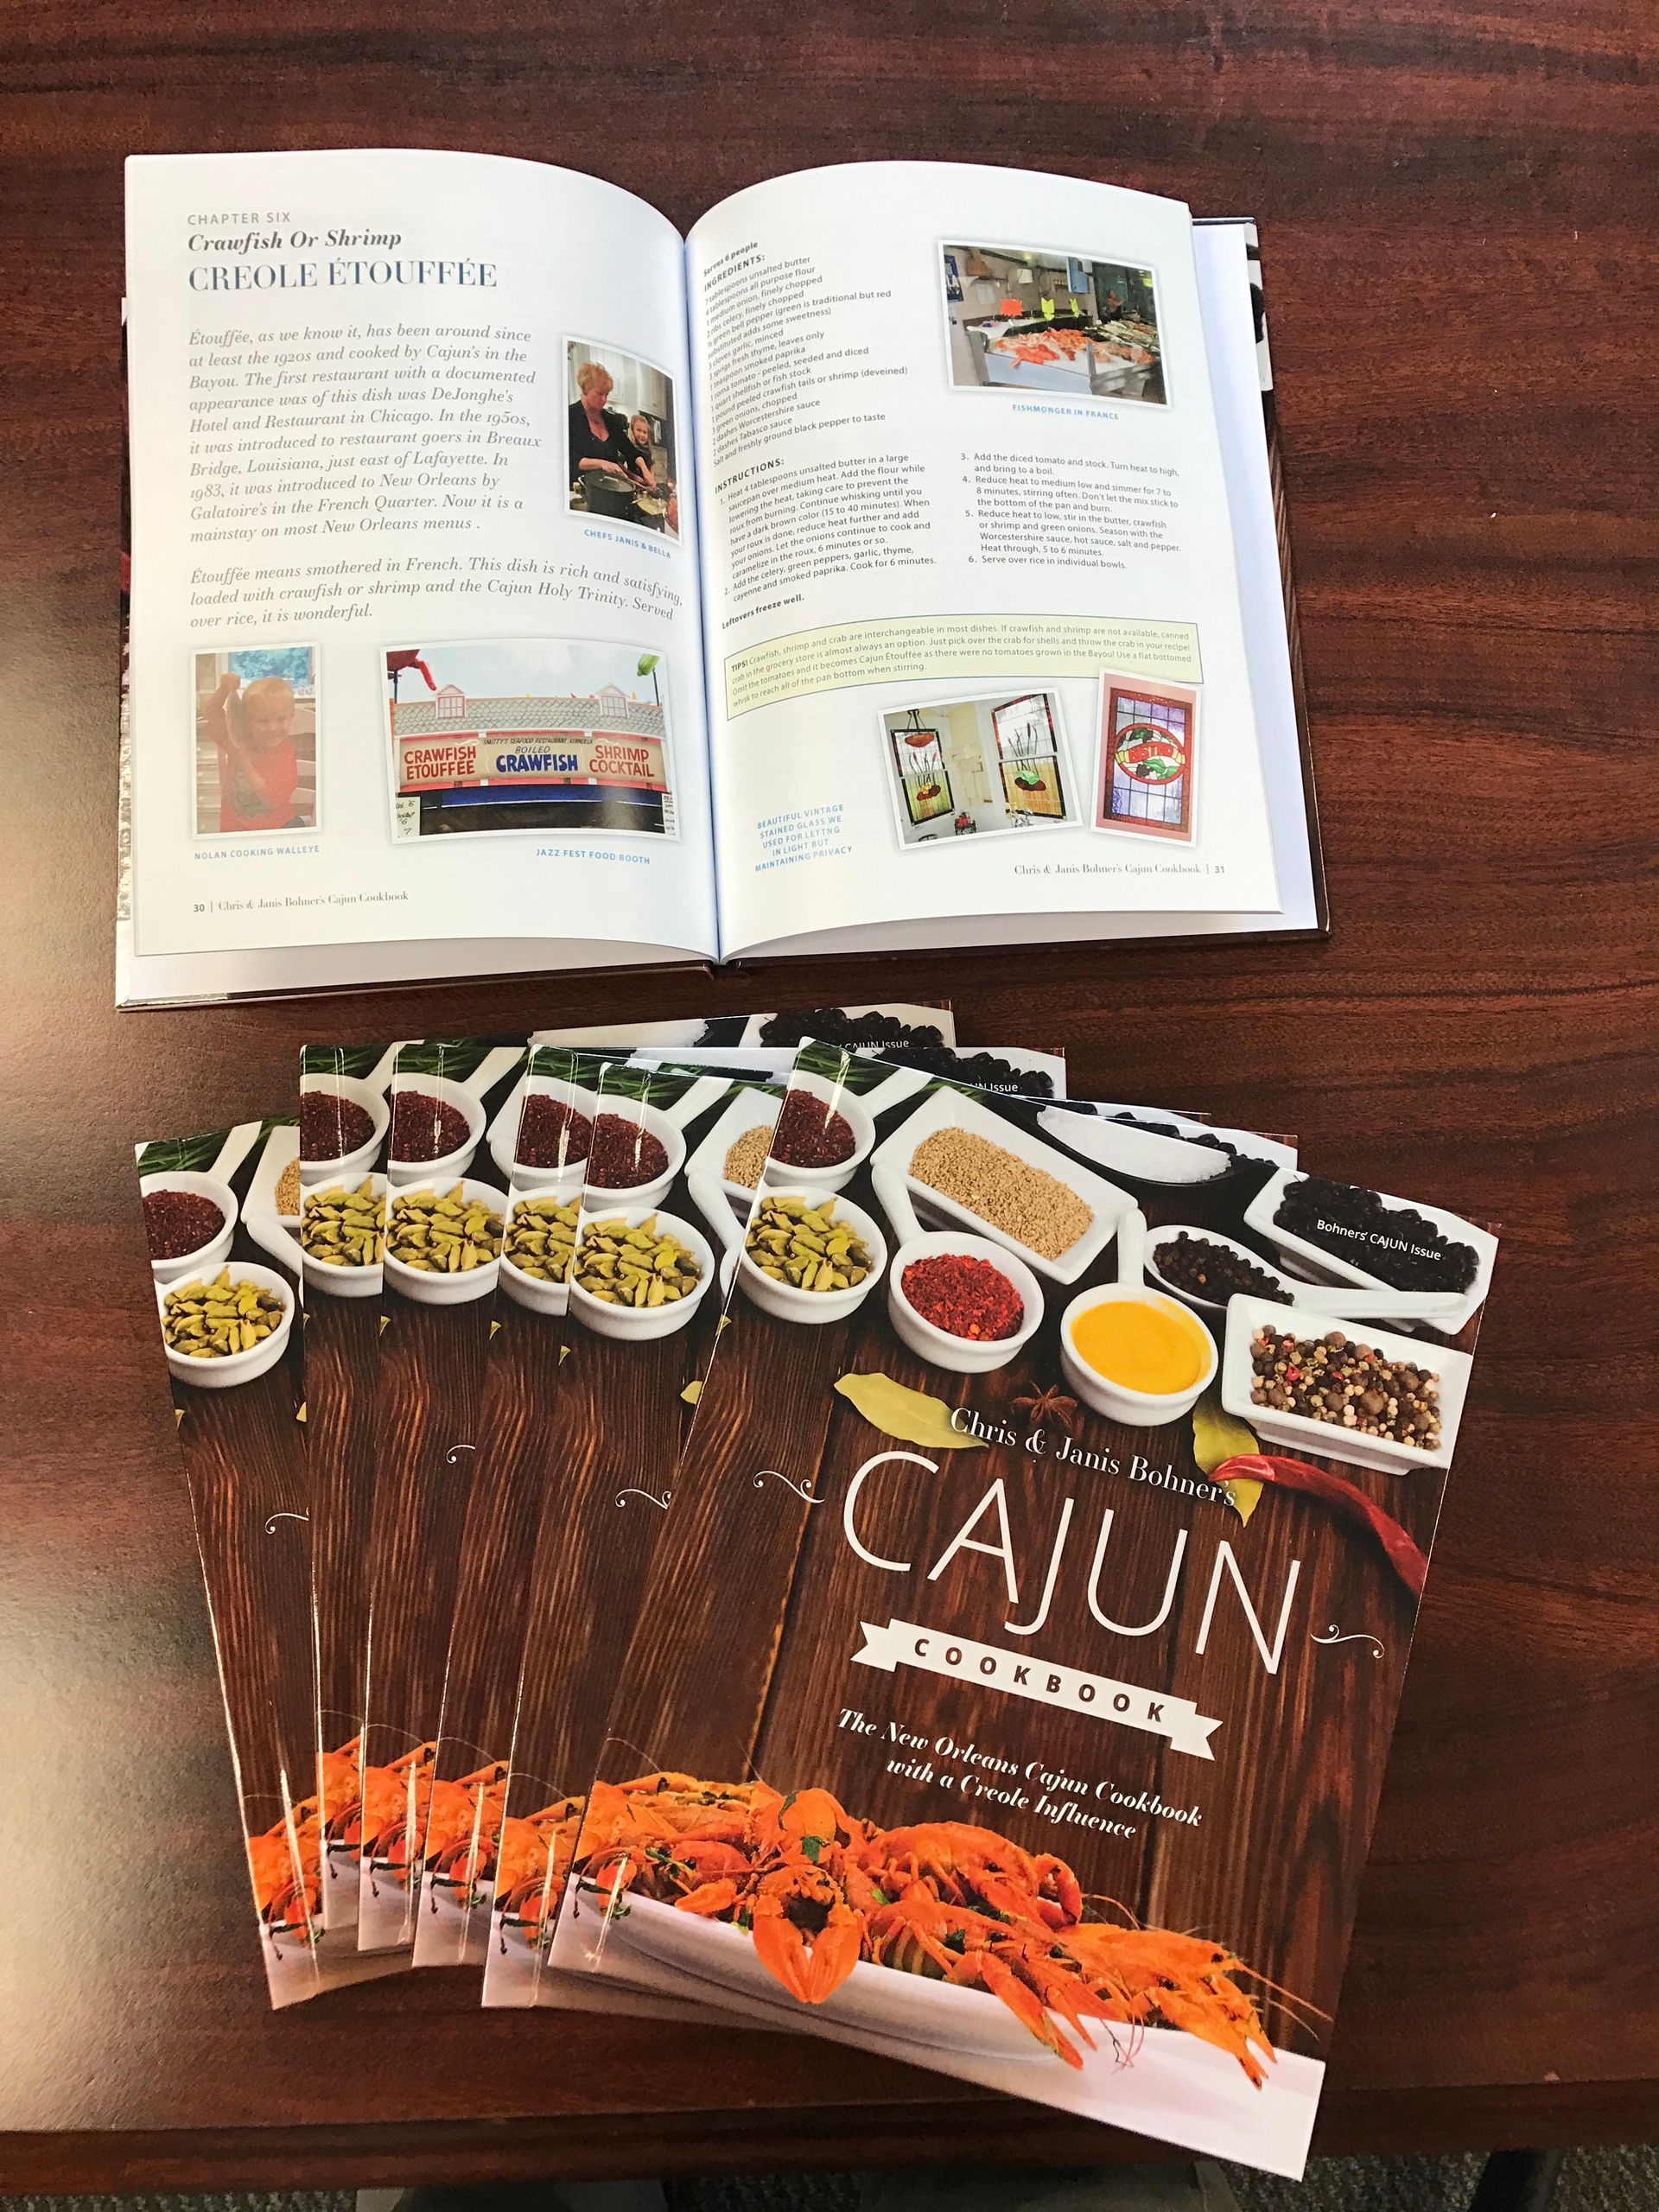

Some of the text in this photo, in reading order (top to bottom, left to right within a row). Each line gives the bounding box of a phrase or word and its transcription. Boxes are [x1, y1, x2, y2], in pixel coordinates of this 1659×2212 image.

[187, 211, 290, 226] CHAPTER SIX
[188, 228, 402, 256] Crawfish Or Shrimp
[702, 241, 758, 277] Serves 6 people
[188, 257, 497, 291] CREOLE ÉTOUFFÉE
[703, 253, 766, 292] INGREDIENTS:
[188, 321, 531, 348] Étouffée, as we know it, has been around since
[188, 343, 527, 367] at least the 1920s and cooked by Cajun's in the
[188, 365, 537, 392] Bayou. The first restaurant with a documented
[188, 386, 513, 414] appearance was of this dish was DeJonghe's
[1012, 404, 1072, 416] FISHMONGER
[1085, 410, 1119, 420] FRANCE
[715, 457, 785, 494] INSTRUCTIONS:
[960, 452, 969, 461] 3.
[973, 452, 992, 461] Add
[993, 452, 1008, 461] the
[1009, 453, 1033, 463] diced
[1034, 455, 1066, 465] tomato
[1066, 458, 1084, 467] and
[1084, 459, 1109, 468] stock.
[1109, 461, 1128, 471] Turn
[1129, 462, 1148, 473] heat
[1159, 466, 1179, 477] high,
[974, 463, 991, 473] and
[992, 464, 1016, 475] bring
[1035, 466, 1054, 475] boil.
[583, 528, 613, 541] CHEFS
[614, 535, 639, 548] JANIS
[647, 543, 671, 559] BELLA
[980, 543, 1103, 556] Heat through, 5 to 6 minutes.
[968, 555, 977, 563] 6.
[981, 554, 1007, 563] Serve
[1028, 556, 1046, 565] rice
[1046, 556, 1056, 565] in
[1056, 556, 1099, 567] individual
[1100, 559, 1128, 569] bowls.
[189, 602, 372, 628] over rice, it is wonderful.
[721, 593, 805, 630] Leftovers freeze well.
[404, 746, 477, 765] CRAWFISH
[514, 746, 551, 754] BOILED
[595, 745, 650, 762] SHRIMP
[406, 760, 476, 780] ETOUFFEE
[495, 754, 578, 773] CRAWFISH
[588, 759, 655, 778] COCKTAIL
[757, 803, 844, 830] BEAUTIFUL VINTAGE
[760, 814, 842, 840] STAINED GLASS WE
[762, 825, 841, 849] USED FOR LETTNG
[772, 837, 829, 857] IN LIGHT BUT
[194, 844, 320, 861] NOLAN COOKING WALLEYE
[535, 848, 650, 865] JAZZ FEST FOOD BOOTH
[754, 844, 853, 872] MAINTAINING PRIVACY
[1014, 863, 1225, 875] Chris & Janis Bohner's Cajun Cookbook 31
[193, 890, 409, 912] 30 Chris & Janis Bohner's Cajun Cookbook
[990, 1083, 1019, 1092] Issue
[1370, 1233, 1408, 1252] CAJUN
[1411, 1244, 1441, 1261] Issue
[949, 1405, 1236, 1509] Chris & Janis Bohner's
[842, 1450, 1301, 1675] CAJUN
[913, 1637, 1166, 1723] COOKBOOK
[837, 1707, 1203, 1828] The New Orleans Cajun Cookbook
[886, 1758, 1137, 1840] with a Creole Influence
